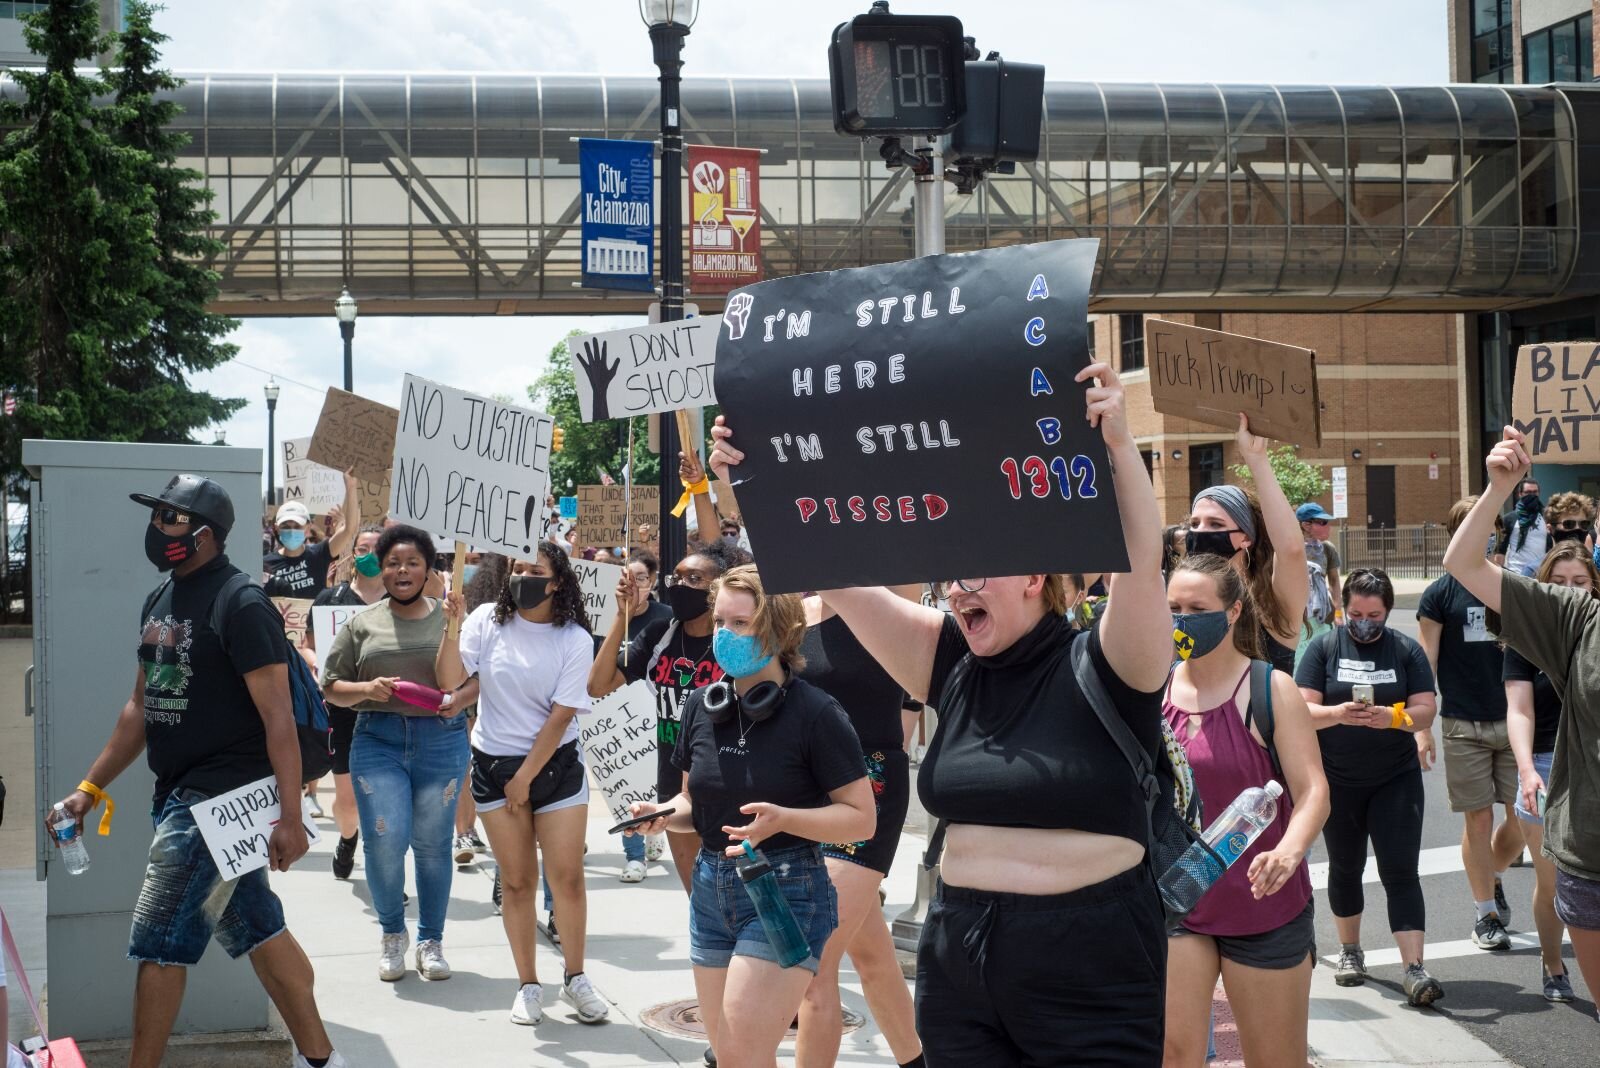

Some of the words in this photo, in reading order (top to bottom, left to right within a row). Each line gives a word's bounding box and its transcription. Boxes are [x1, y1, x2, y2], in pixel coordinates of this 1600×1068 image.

[598, 163, 621, 199] City
[620, 178, 627, 194] of
[586, 193, 650, 226] Kalamazoo
[692, 254, 736, 272] KALAMAZOO
[737, 255, 758, 272] MALL
[763, 308, 812, 342] I'M
[855, 286, 967, 328] STILL
[629, 325, 701, 368] DON'T
[1154, 332, 1201, 390] Fuck
[625, 363, 716, 411] SHOOT
[792, 353, 906, 397] HERE
[403, 382, 443, 439] NO
[453, 397, 551, 472] JUSTICE
[770, 432, 824, 463] I'M
[856, 419, 961, 454] STILL
[396, 457, 430, 520] NO
[1000, 453, 1098, 500] 1312
[577, 515, 605, 527] NEVER
[584, 503, 605, 514] THAT
[795, 493, 948, 523] PISSED
[285, 569, 308, 583] IVES
[290, 577, 315, 591] TTER
